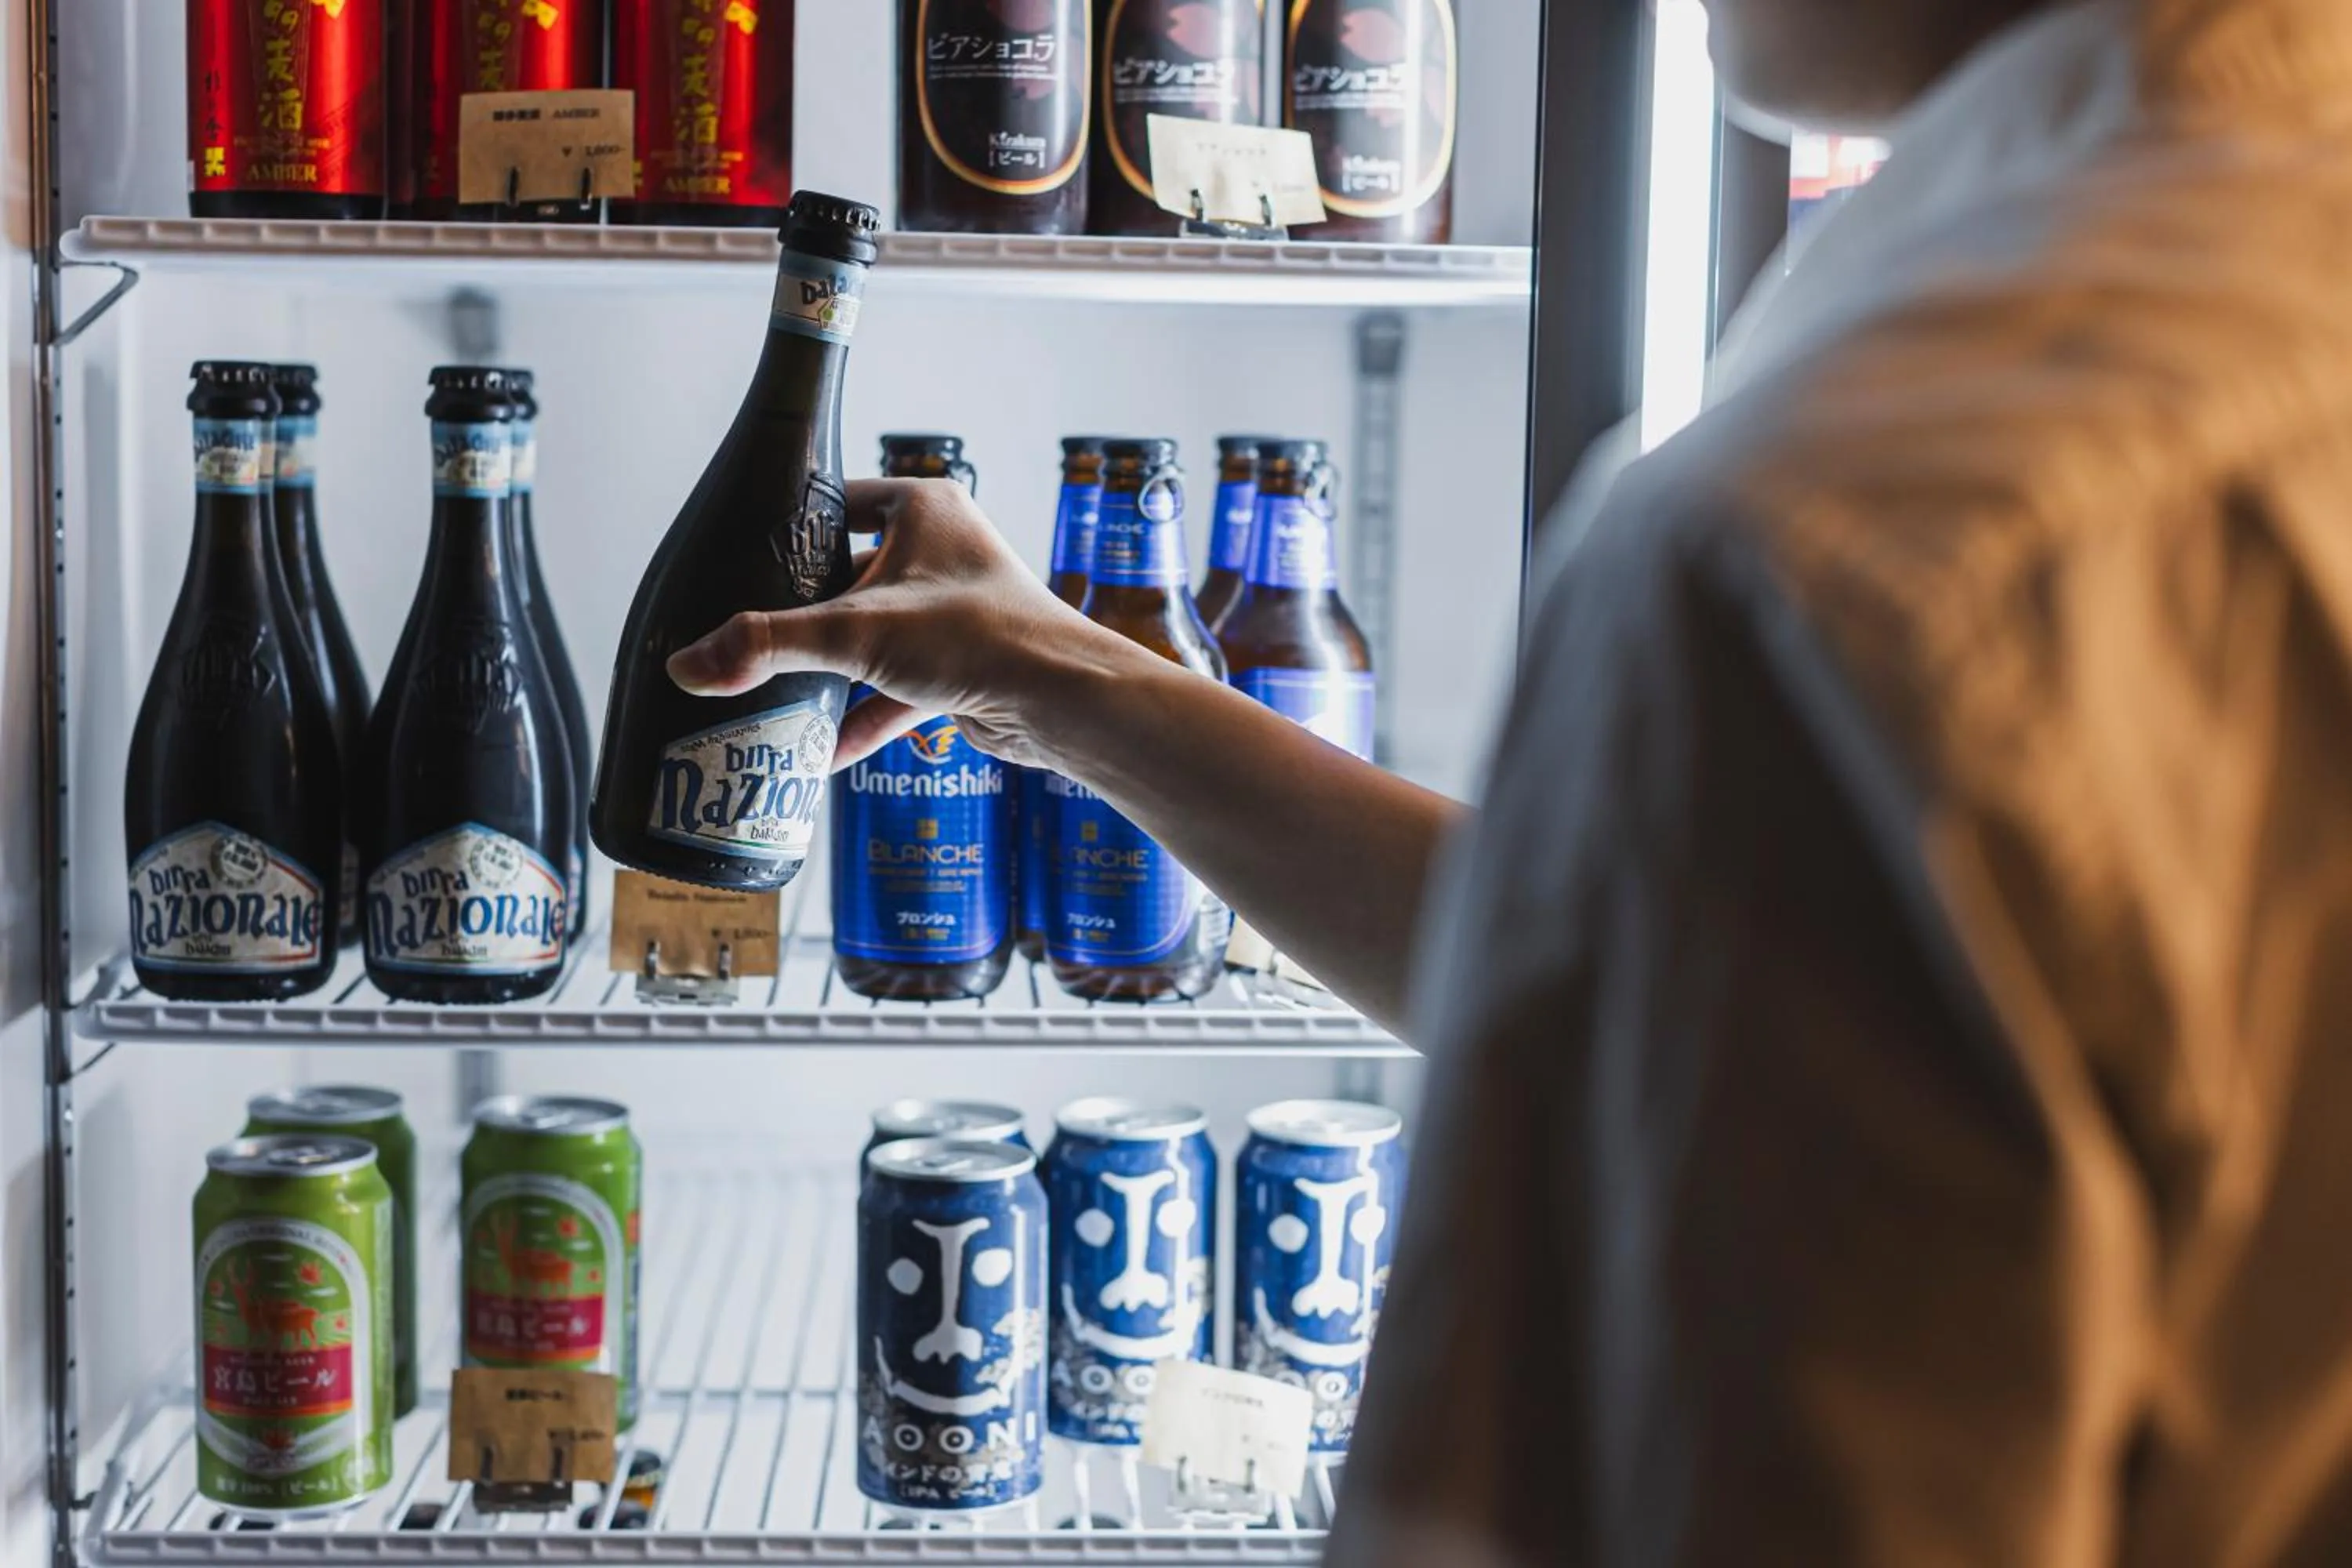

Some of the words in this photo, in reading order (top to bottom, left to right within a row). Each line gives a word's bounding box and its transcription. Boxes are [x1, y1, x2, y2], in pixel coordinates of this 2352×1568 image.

[928, 33, 1057, 62] ビアショコラ
[849, 760, 1003, 798] Umenishiki
[868, 838, 985, 863] BLANCHE
[1072, 847, 1150, 869] NCHE
